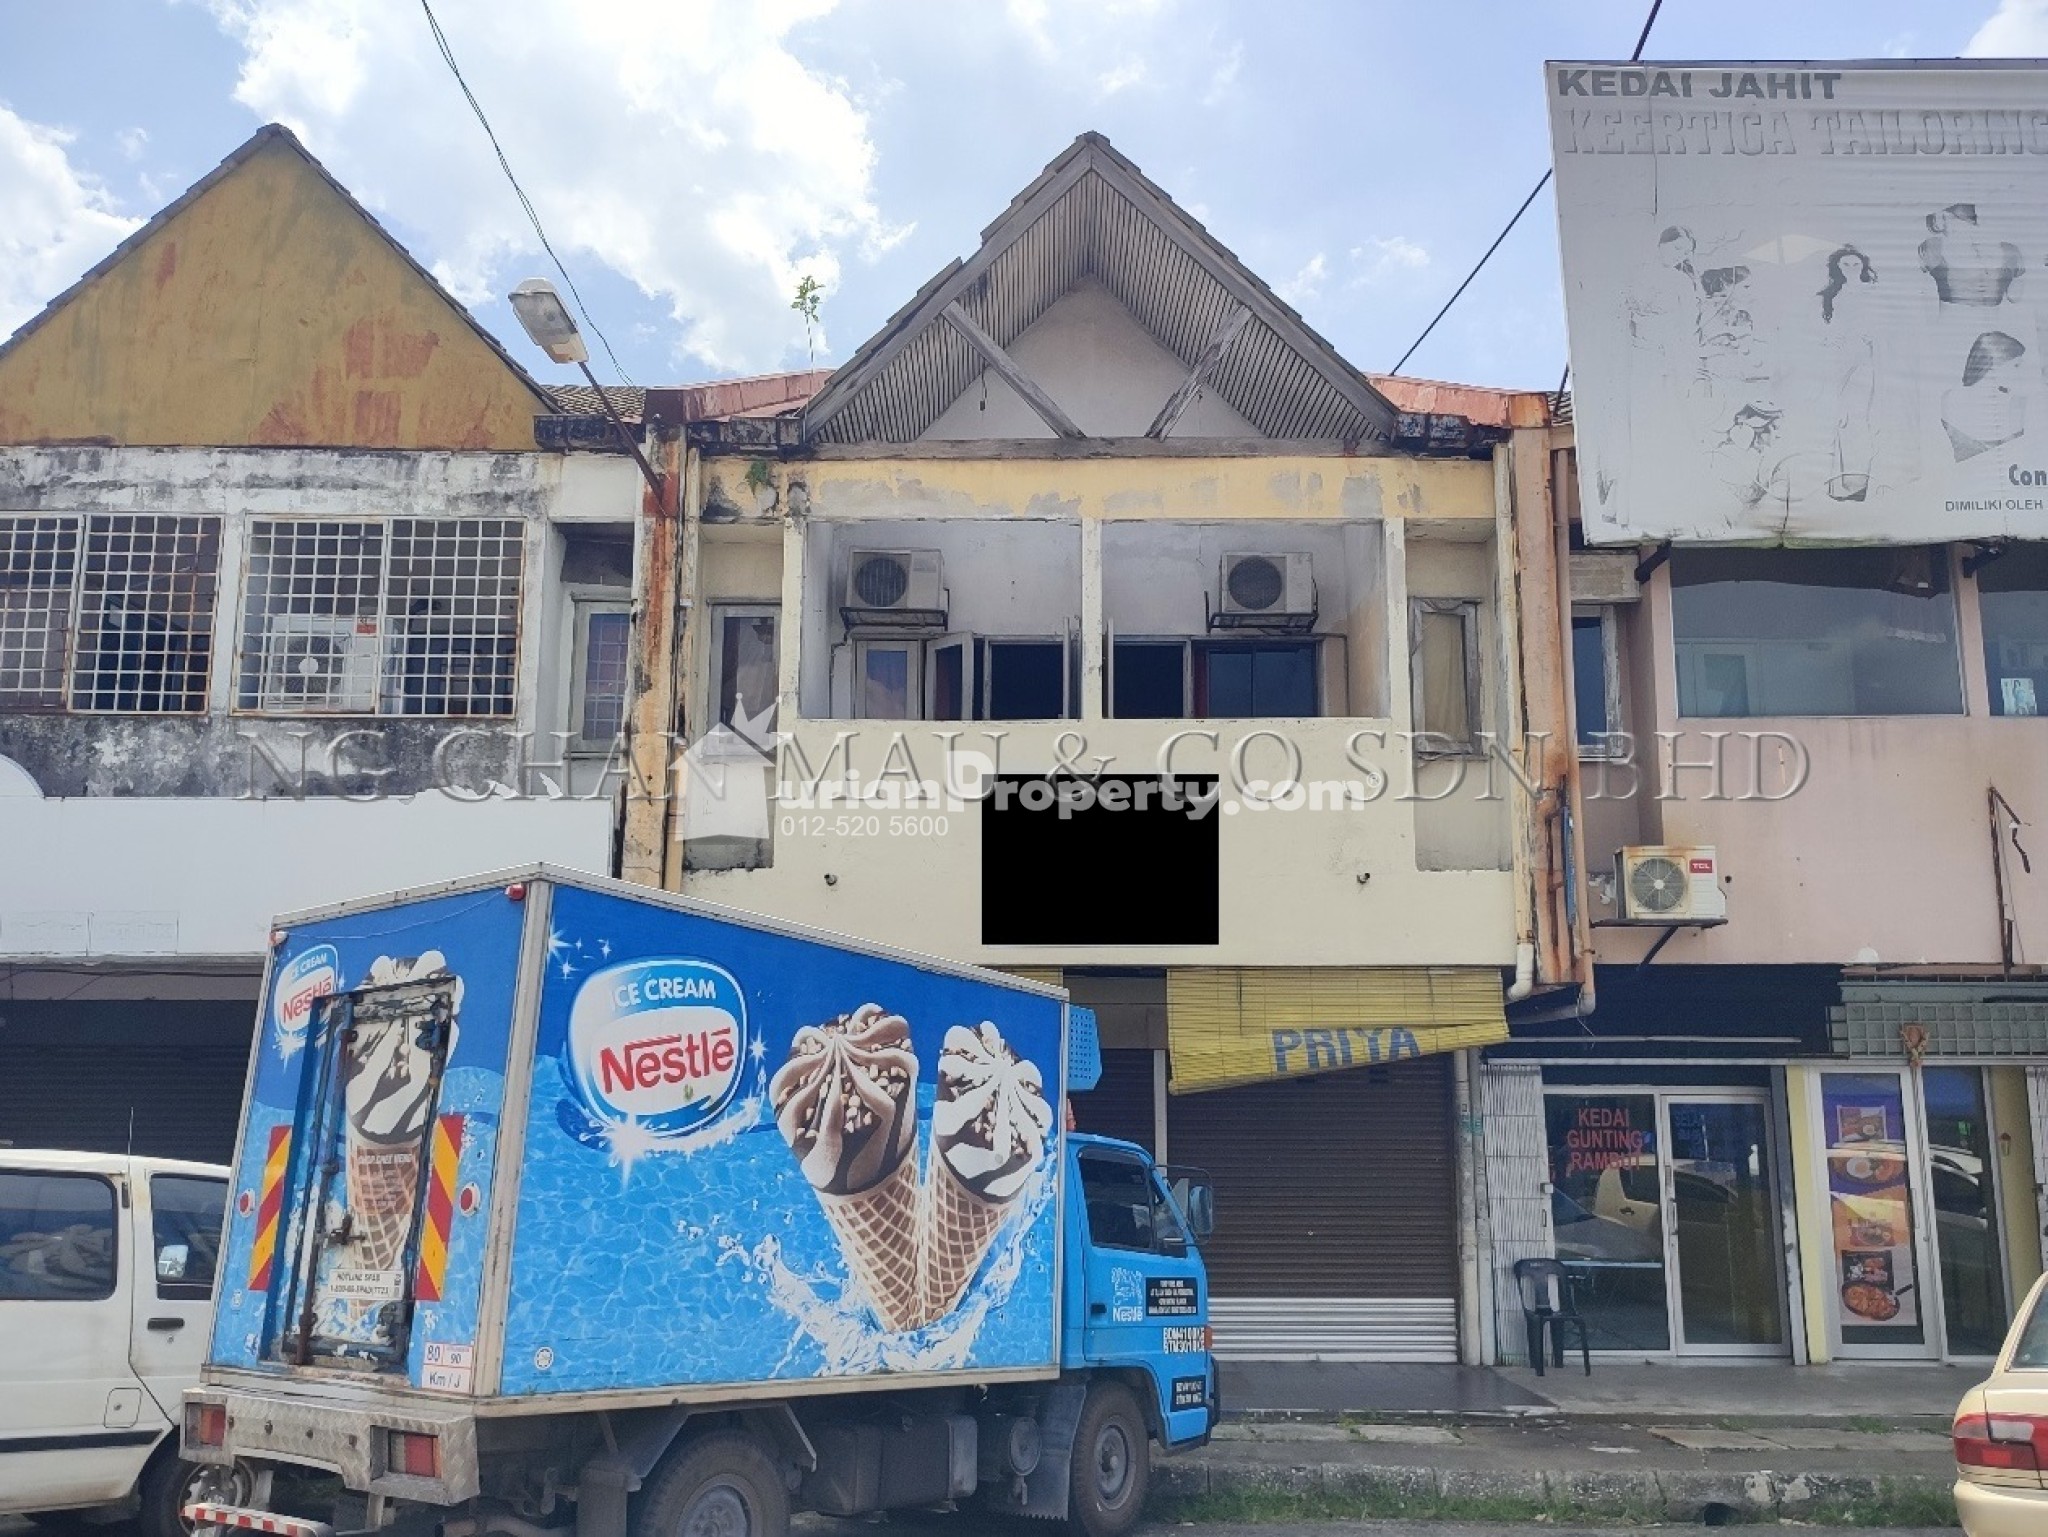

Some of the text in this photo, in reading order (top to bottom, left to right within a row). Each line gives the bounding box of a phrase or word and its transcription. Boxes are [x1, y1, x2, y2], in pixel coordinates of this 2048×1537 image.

[1557, 69, 1842, 99] KEDAI JAHIT
[1560, 107, 1798, 155] KEERTICA
[1945, 499, 2044, 512] DIMILIKI OLEH
[643, 976, 716, 1001] CREAM
[1272, 1026, 1422, 1072] PRIYA
[601, 1027, 735, 1095] Nestlé
[1578, 1108, 1630, 1127] KEDAI
[1567, 1130, 1643, 1149] GUNTING
[427, 1345, 441, 1362] 80
[450, 1353, 462, 1364] 90
